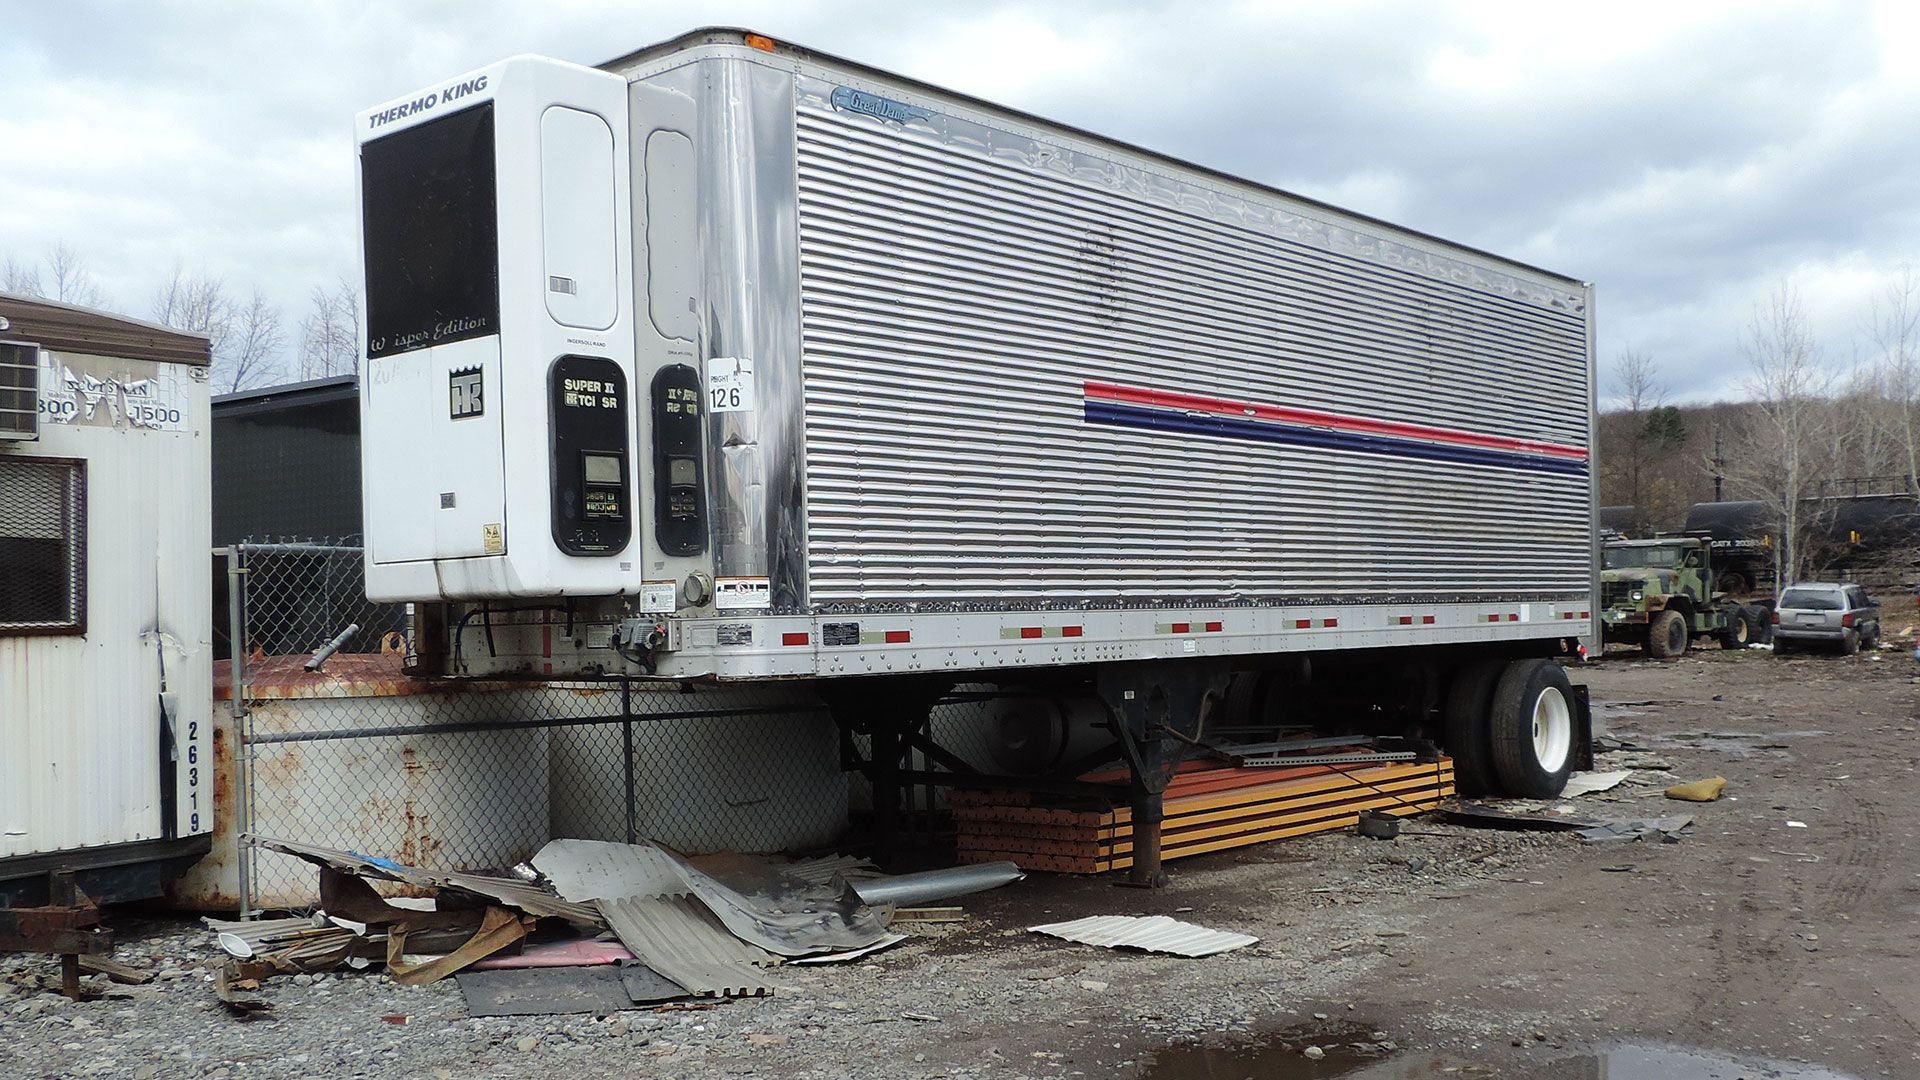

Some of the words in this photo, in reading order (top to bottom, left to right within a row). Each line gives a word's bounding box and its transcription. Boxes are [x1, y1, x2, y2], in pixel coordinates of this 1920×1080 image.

[368, 93, 438, 129] THERMO
[441, 75, 488, 104] KING
[850, 92, 879, 114] Great
[880, 102, 906, 120] Dane
[433, 316, 486, 340] Edition
[564, 378, 602, 393] SUPER
[602, 396, 617, 409] SR
[1710, 540, 1732, 548] GATX
[188, 721, 199, 832] 26319
